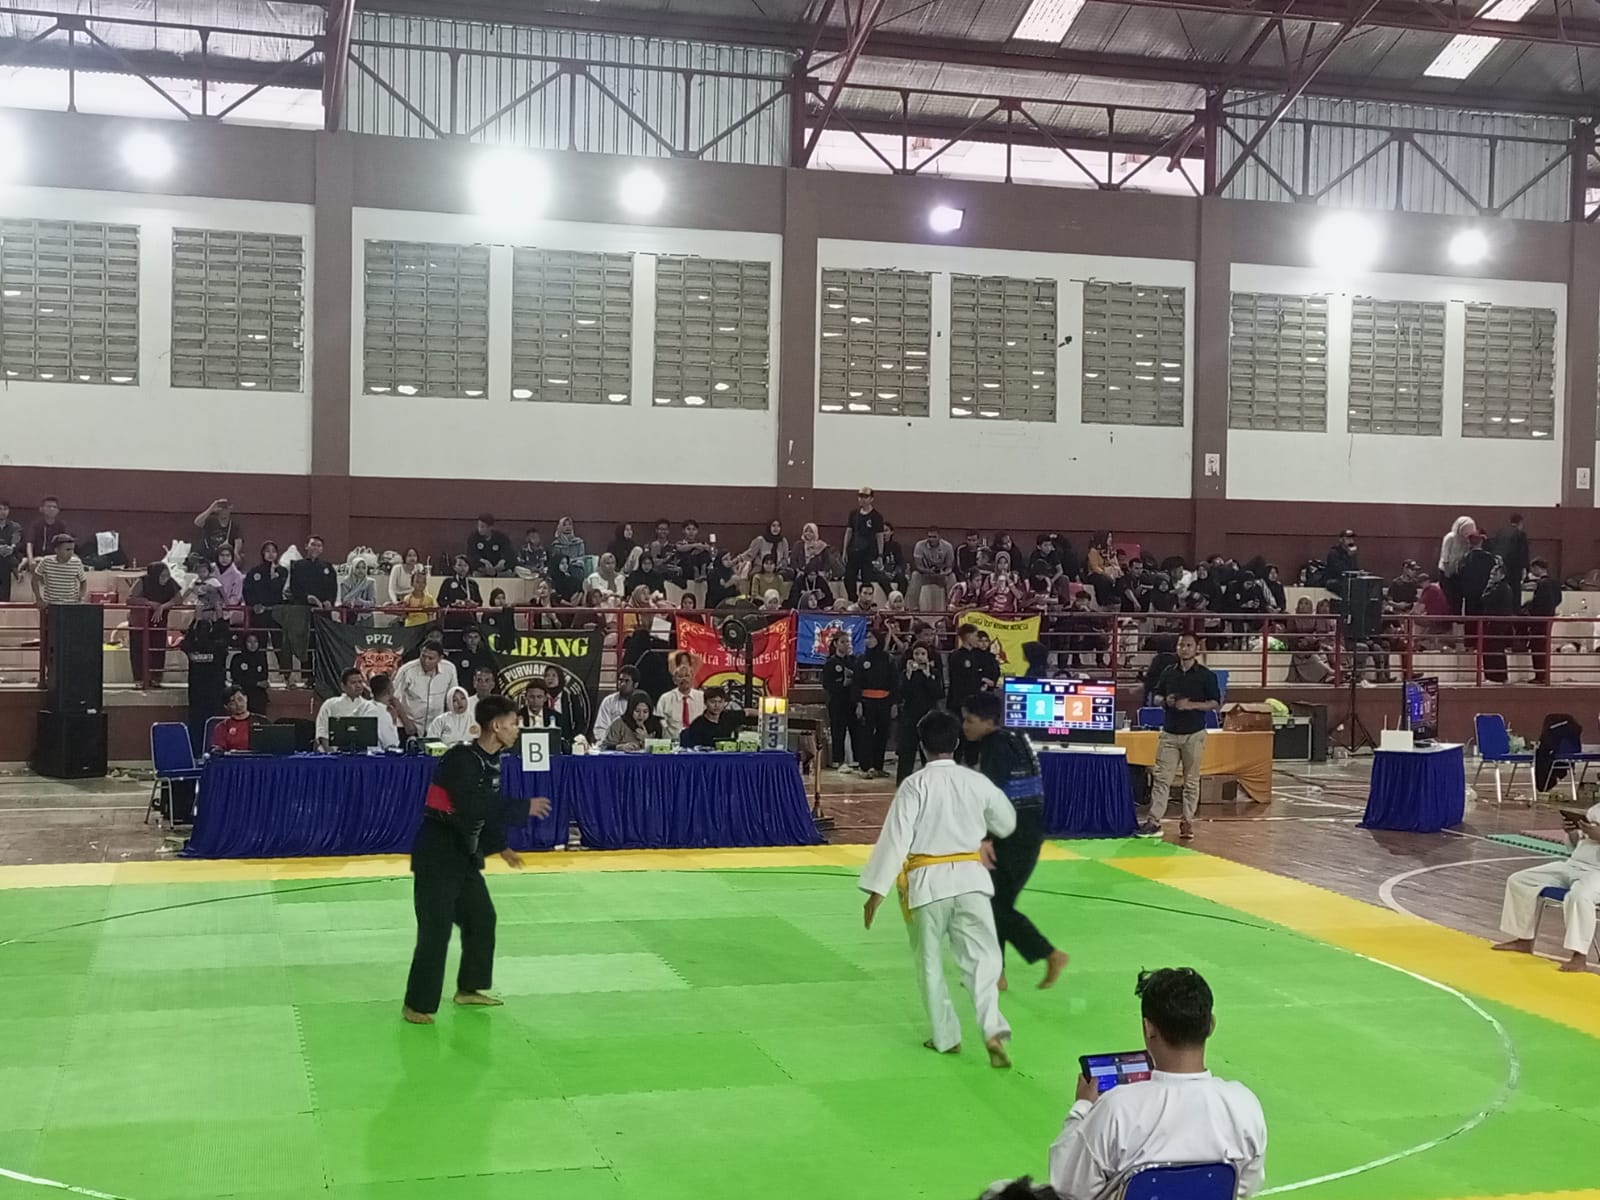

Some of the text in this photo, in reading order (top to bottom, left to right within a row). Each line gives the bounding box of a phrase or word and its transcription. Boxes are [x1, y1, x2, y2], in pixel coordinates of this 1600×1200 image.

[365, 634, 393, 645] PPTL
[724, 650, 780, 666] Indnesia
[1072, 701, 1084, 717] 2
[769, 716, 779, 731] 2
[768, 732, 778, 748] 3
[529, 742, 543, 763] B
